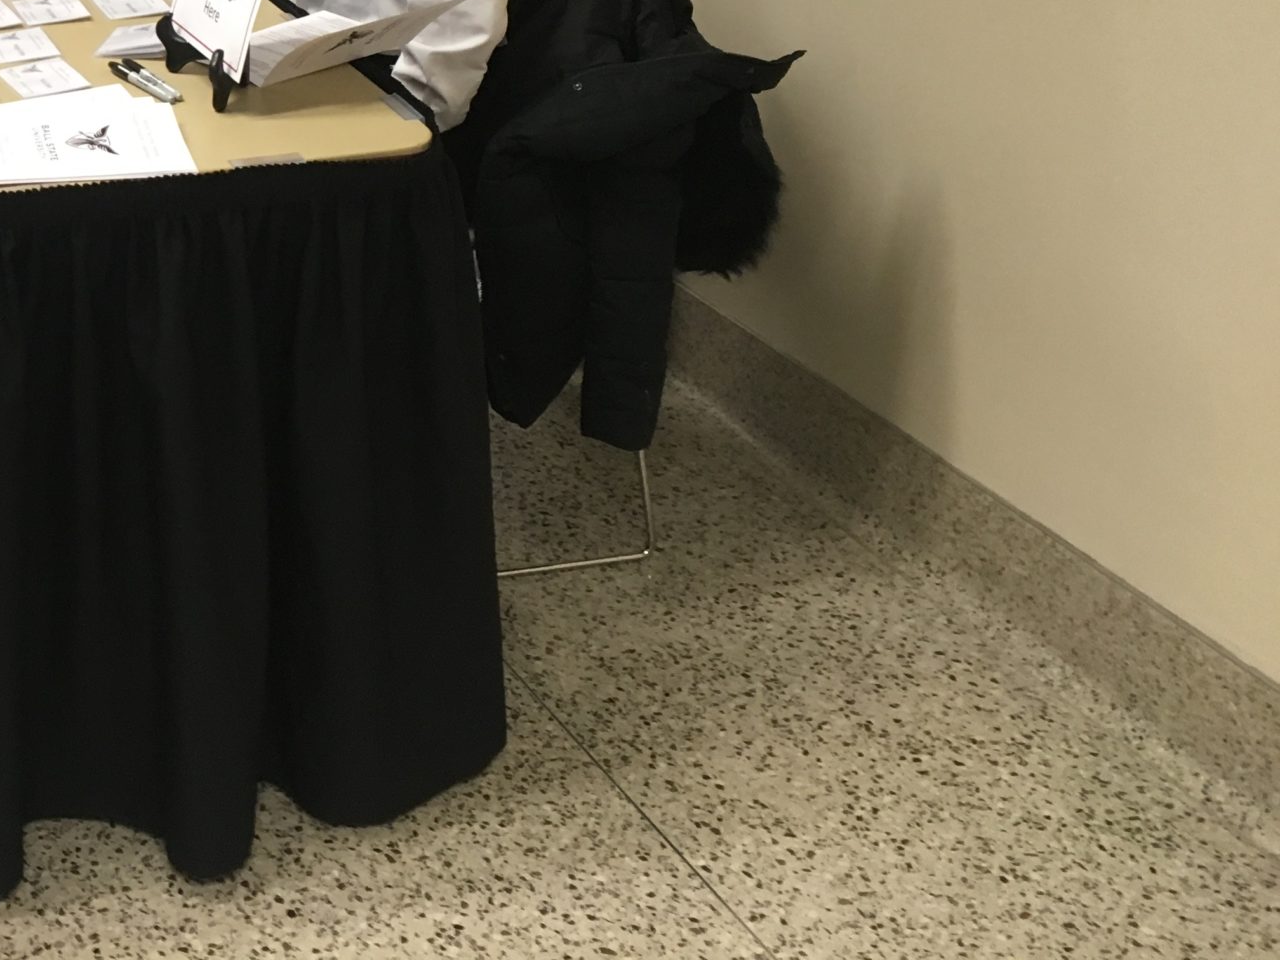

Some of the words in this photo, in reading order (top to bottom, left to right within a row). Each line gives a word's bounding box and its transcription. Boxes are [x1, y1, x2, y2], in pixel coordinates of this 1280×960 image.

[203, 0, 220, 23] Here
[41, 124, 52, 142] BALL
[45, 142, 59, 161] STATE
